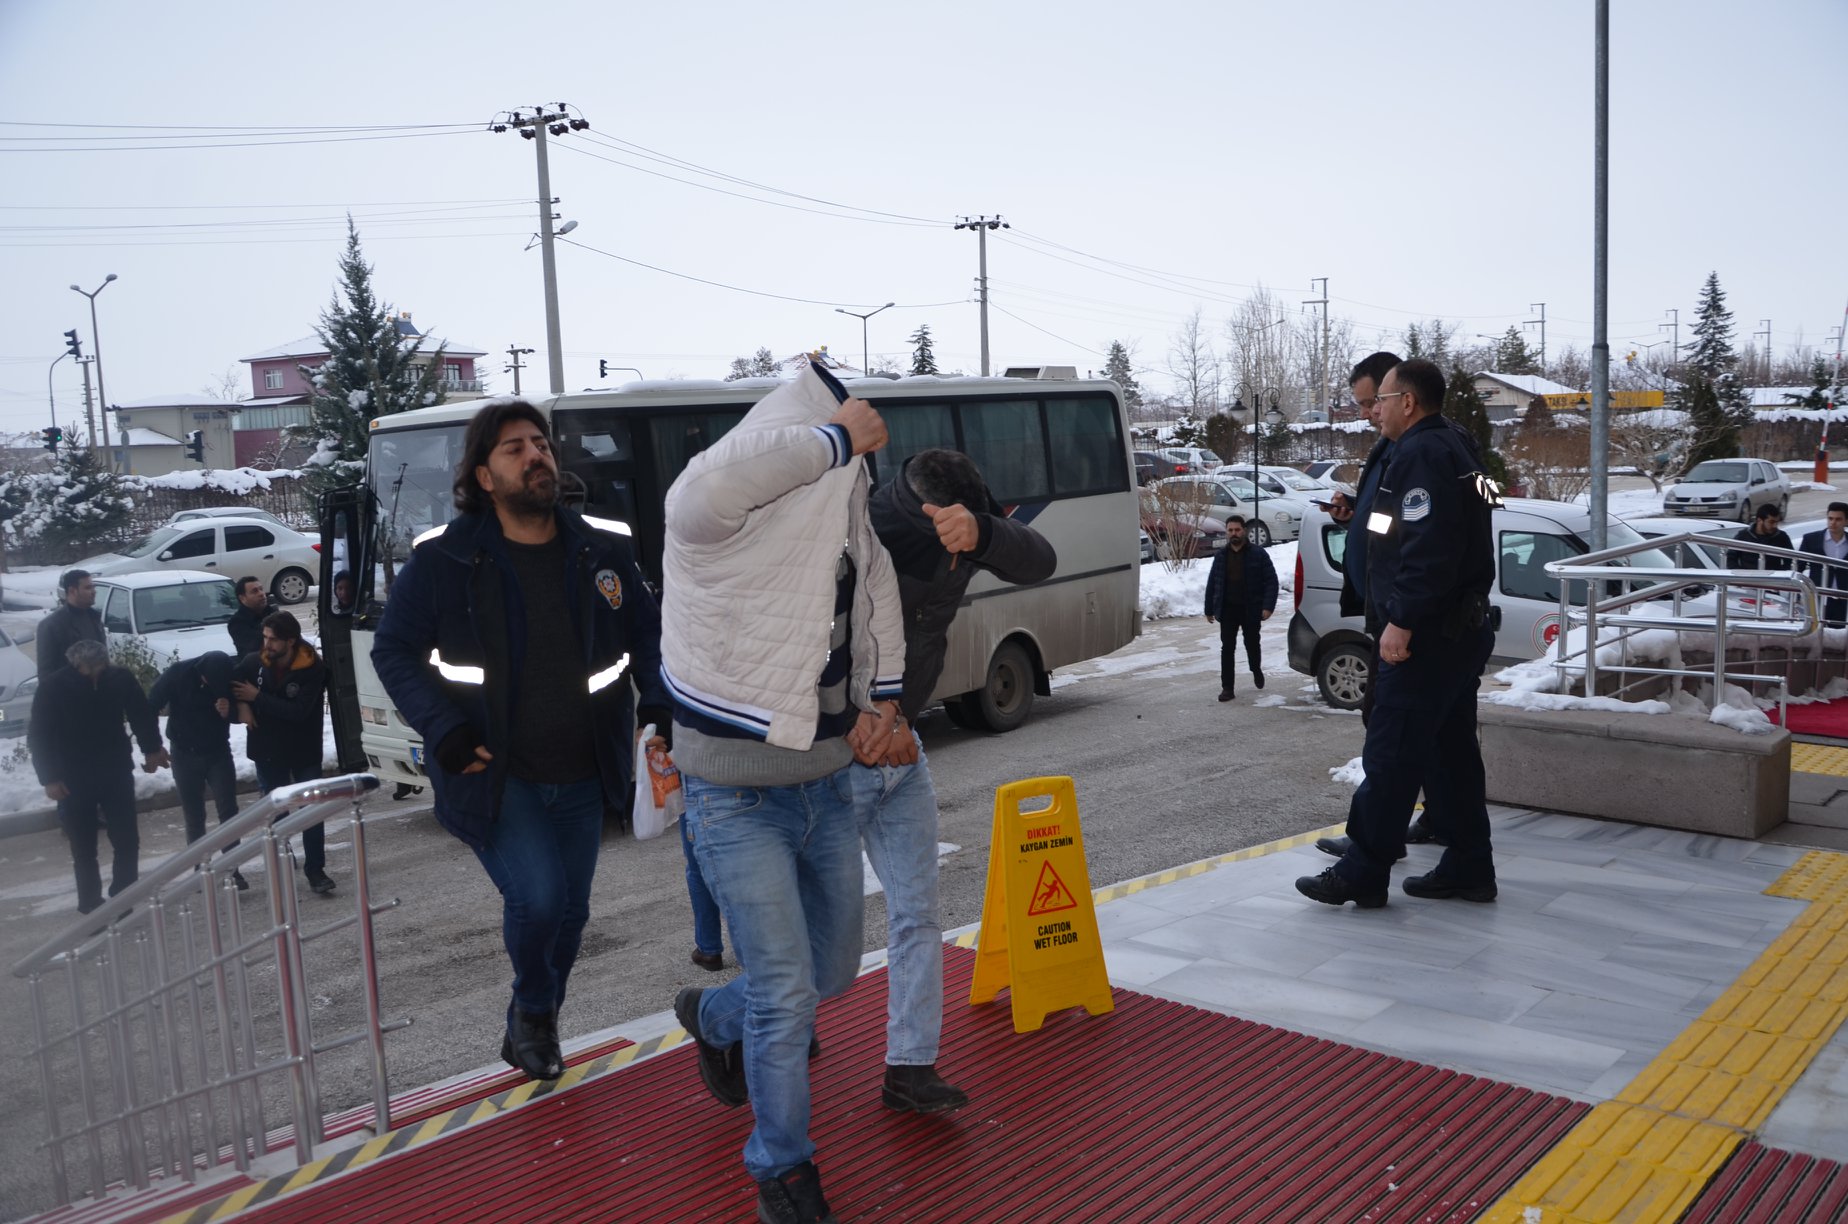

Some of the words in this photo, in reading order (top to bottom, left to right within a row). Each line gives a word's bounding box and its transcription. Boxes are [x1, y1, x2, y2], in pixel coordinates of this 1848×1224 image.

[1027, 825, 1061, 839] DİKKAT!
[1020, 840, 1048, 853] KAYGAN
[1050, 835, 1073, 848] ZEMİN
[1038, 921, 1071, 936] CAUTION
[1034, 937, 1051, 950] WET
[1053, 932, 1078, 946] FLOOR
